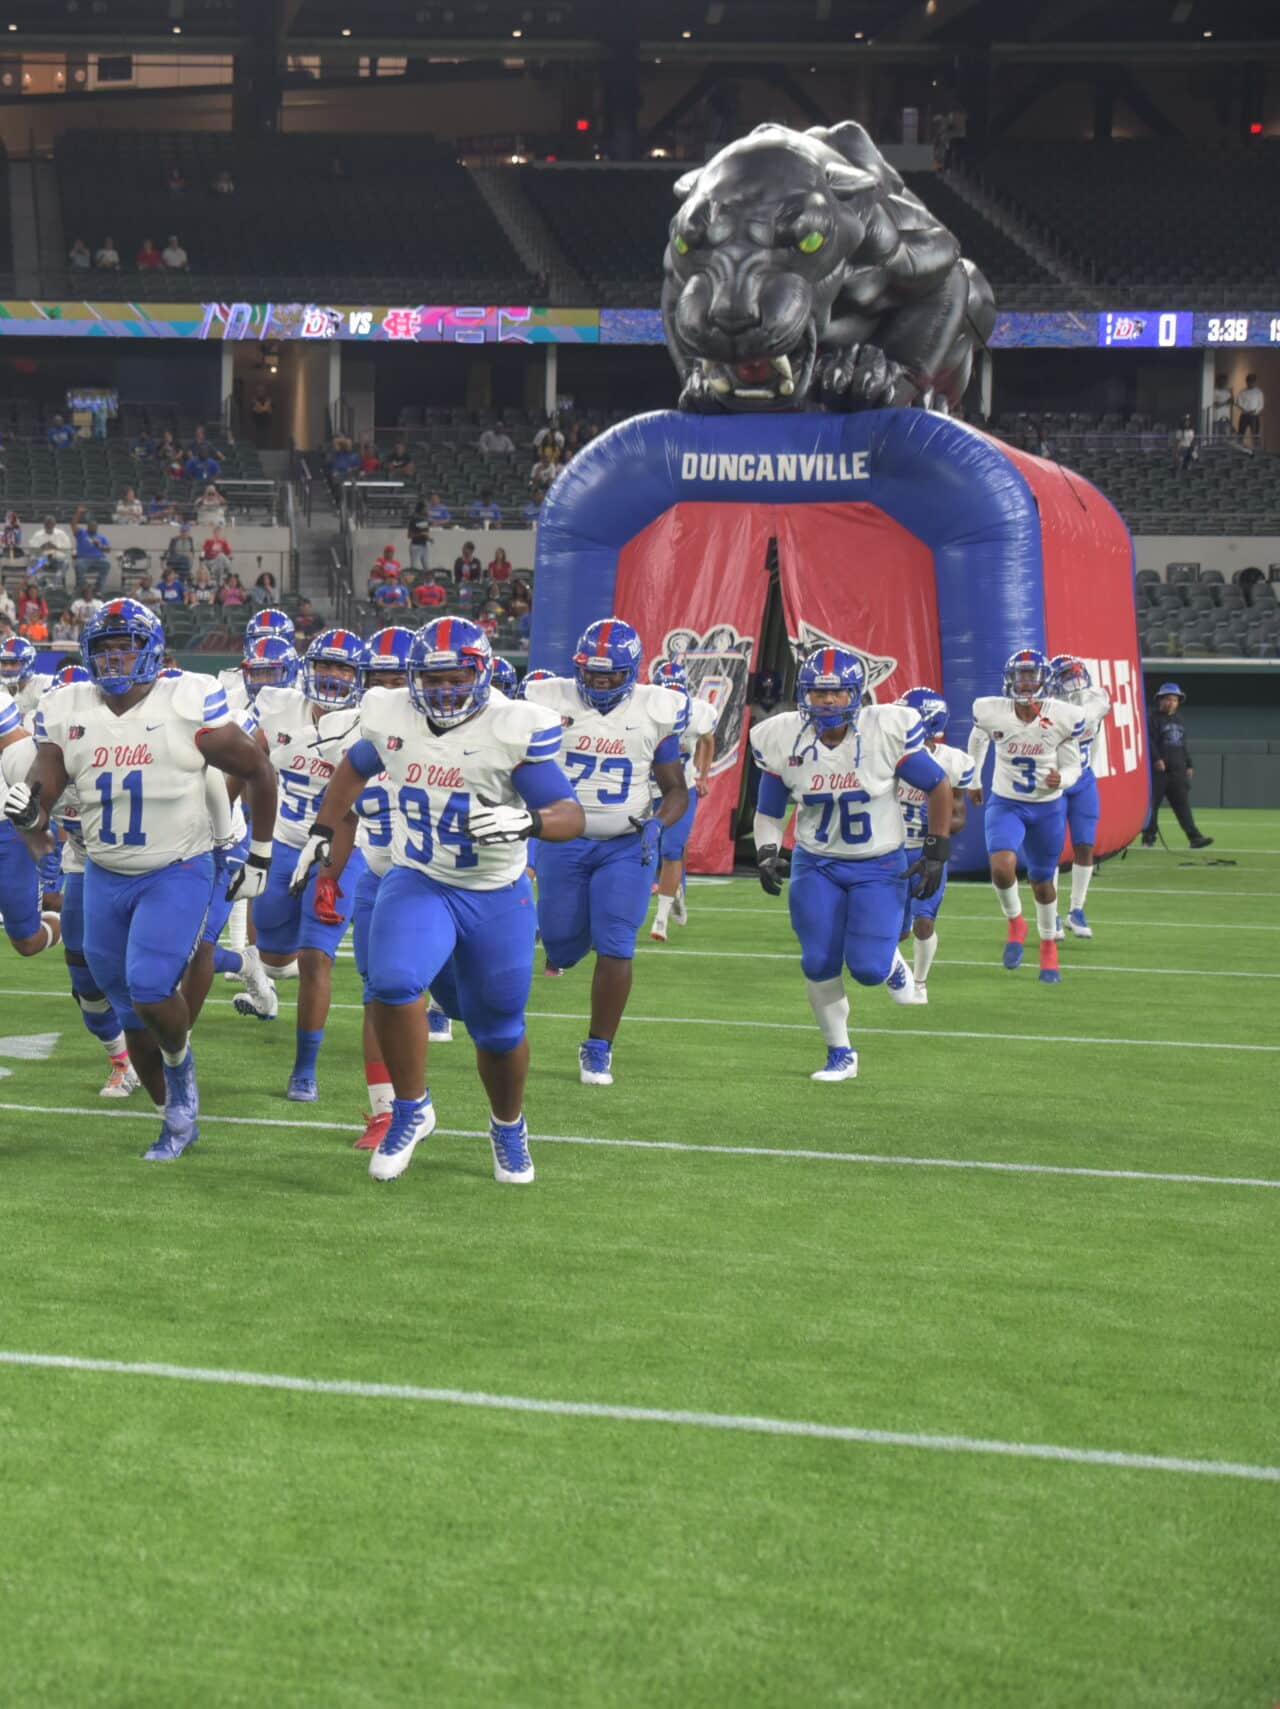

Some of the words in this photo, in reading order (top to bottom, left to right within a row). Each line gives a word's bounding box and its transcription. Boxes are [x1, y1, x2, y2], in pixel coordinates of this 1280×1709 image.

[349, 311, 373, 334] VS
[1158, 314, 1177, 347] 0
[1208, 318, 1248, 342] 3:38
[681, 450, 871, 482] DUNCANVILLE
[92, 743, 153, 768] D'Ville
[575, 735, 626, 755] D'Ville
[405, 763, 465, 788] D'Ville
[565, 750, 633, 805] 73
[810, 772, 860, 791] D'Ville
[1011, 757, 1036, 794] 3
[95, 770, 146, 846] 11
[802, 790, 873, 846] 76
[398, 785, 480, 868] 94
